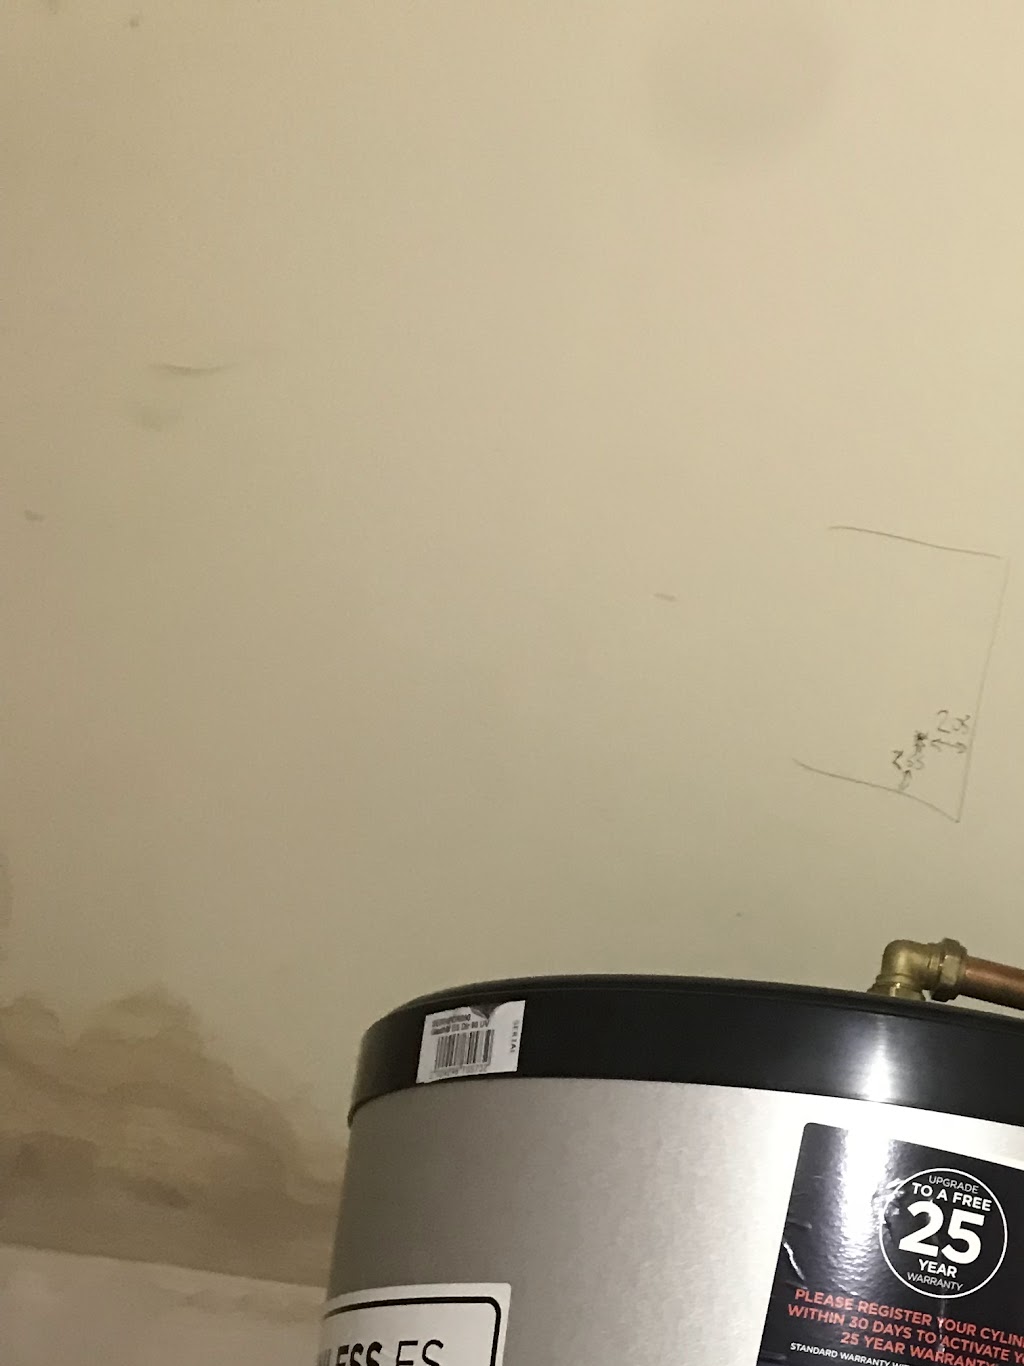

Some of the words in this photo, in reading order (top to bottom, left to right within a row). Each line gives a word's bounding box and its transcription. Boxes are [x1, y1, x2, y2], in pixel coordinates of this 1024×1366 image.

[911, 1181, 933, 1197] TO
[935, 1188, 947, 1201] A
[952, 1191, 992, 1211] FREE
[928, 1174, 979, 1194] UPGRADE
[898, 1200, 985, 1264] 25
[918, 1258, 957, 1278] YEAR
[907, 1271, 963, 1291] WARRANTY
[794, 1286, 854, 1310] PLEASE
[857, 1300, 932, 1326] REGISTER
[936, 1316, 976, 1336] YOUR
[787, 1303, 845, 1326] WITHIN
[848, 1315, 869, 1329] 30
[871, 1320, 912, 1339] DAYS
[916, 1329, 937, 1344] TO
[939, 1335, 1010, 1361] ACTIVATE
[839, 1331, 859, 1345] 25
[863, 1335, 905, 1354] YEAR
[790, 1342, 838, 1358] STANDARD
[839, 1351, 890, 1366] WARRANTY
